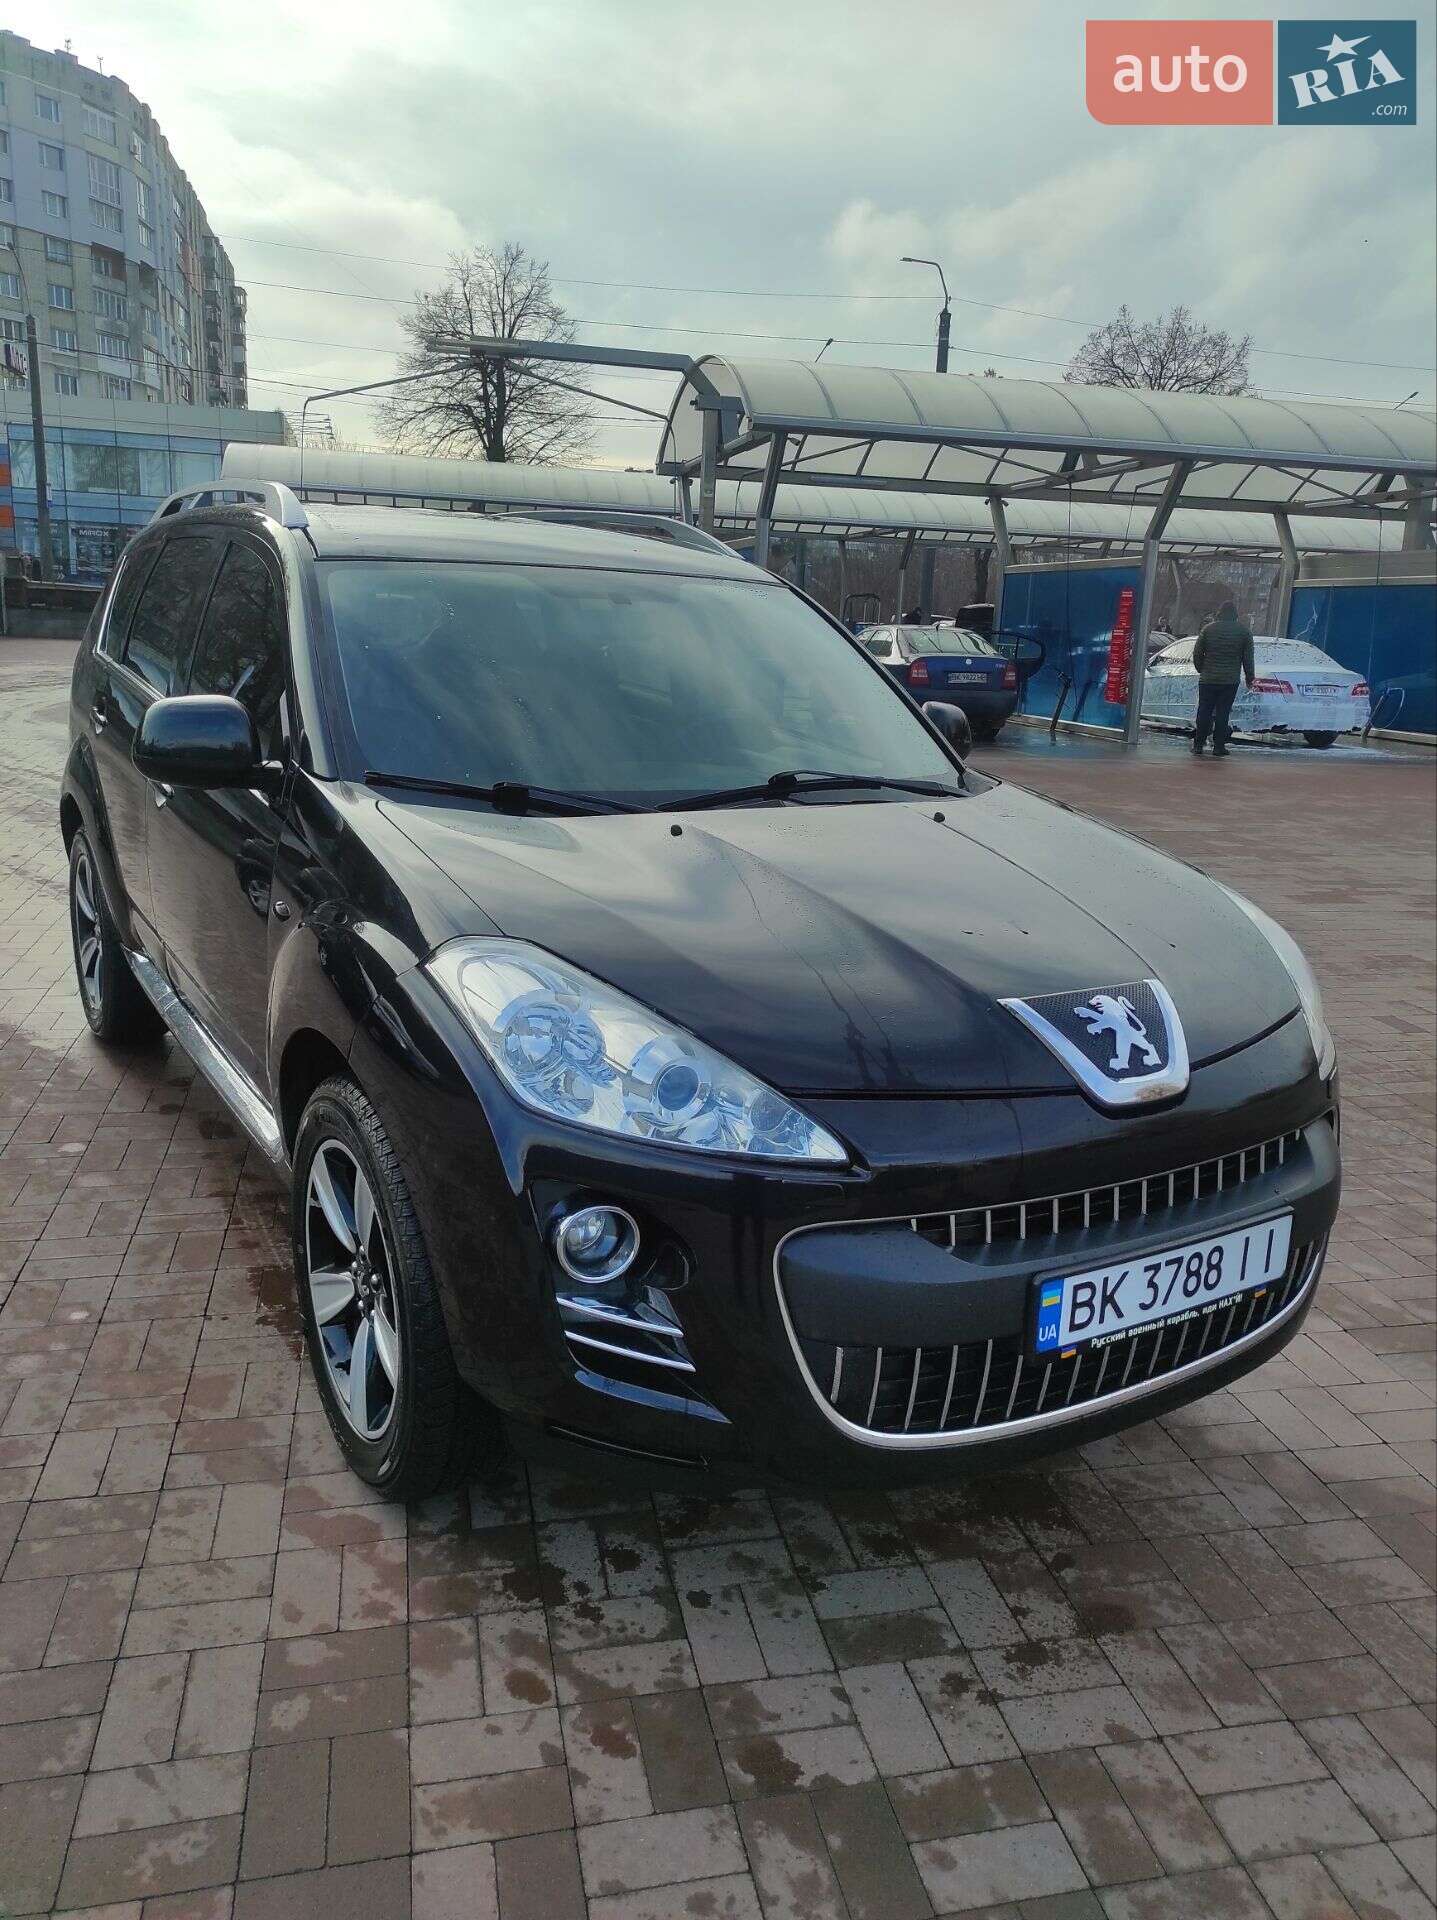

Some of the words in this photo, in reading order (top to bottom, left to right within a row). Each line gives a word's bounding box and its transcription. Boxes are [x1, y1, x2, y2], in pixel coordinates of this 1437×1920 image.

[1068, 1270, 1130, 1333] BK
[1138, 1245, 1224, 1311] 3788
[1039, 1323, 1058, 1342] UA
[1091, 1330, 1126, 1348] Русский
[1127, 1319, 1165, 1337] военный
[1202, 1303, 1218, 1315] иди
